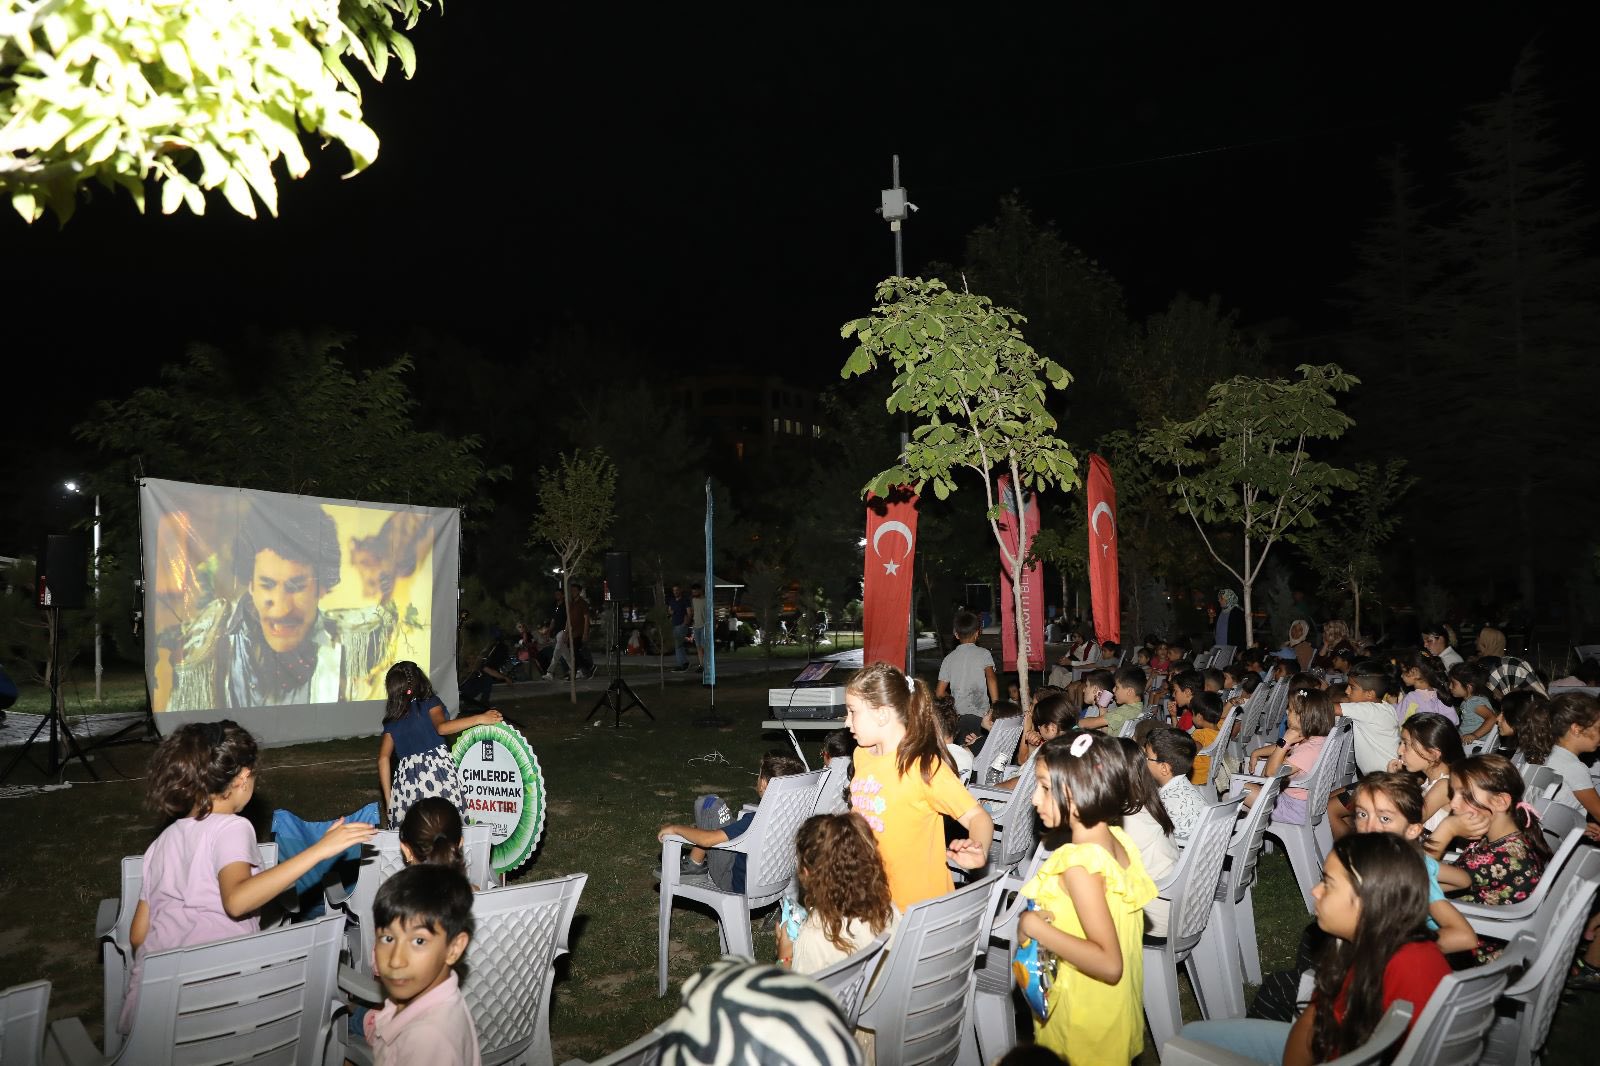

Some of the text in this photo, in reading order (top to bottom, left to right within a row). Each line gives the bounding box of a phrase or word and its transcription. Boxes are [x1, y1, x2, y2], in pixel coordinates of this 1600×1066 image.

[462, 785, 521, 798] OP OYNAMAK
[466, 799, 517, 813] ASAKTIR!
